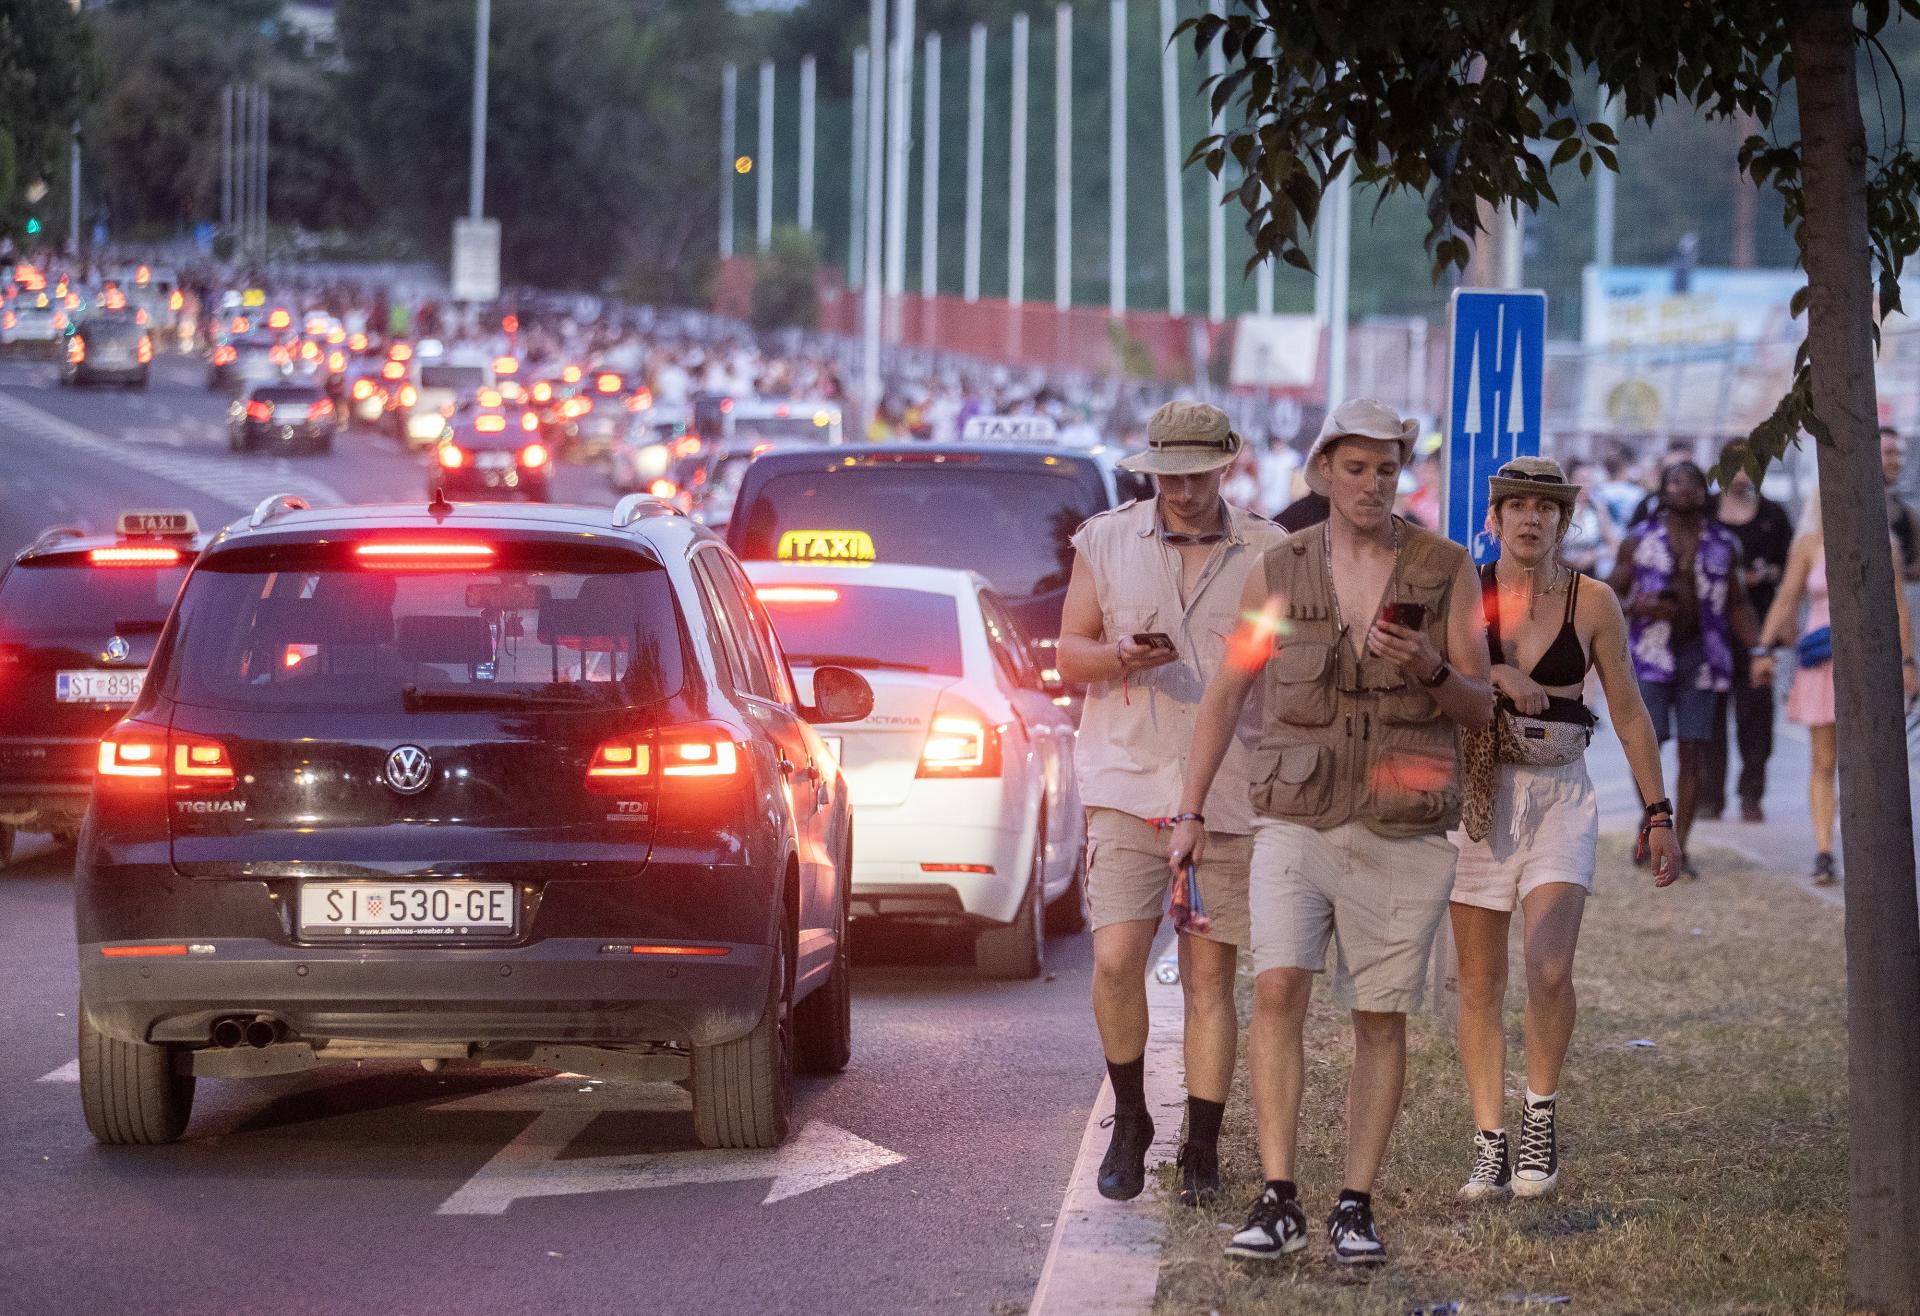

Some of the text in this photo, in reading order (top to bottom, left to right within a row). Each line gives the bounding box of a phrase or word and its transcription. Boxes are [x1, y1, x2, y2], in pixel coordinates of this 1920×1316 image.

[978, 421, 1031, 435] TAXI
[139, 515, 175, 530] TAXI
[792, 536, 858, 558] TAXI
[72, 675, 94, 696] ST
[176, 800, 247, 813] TIGUAN
[617, 801, 649, 813] TDI
[390, 889, 505, 921] 530-GE
[358, 927, 455, 935] www.autohaus-weeber.de
